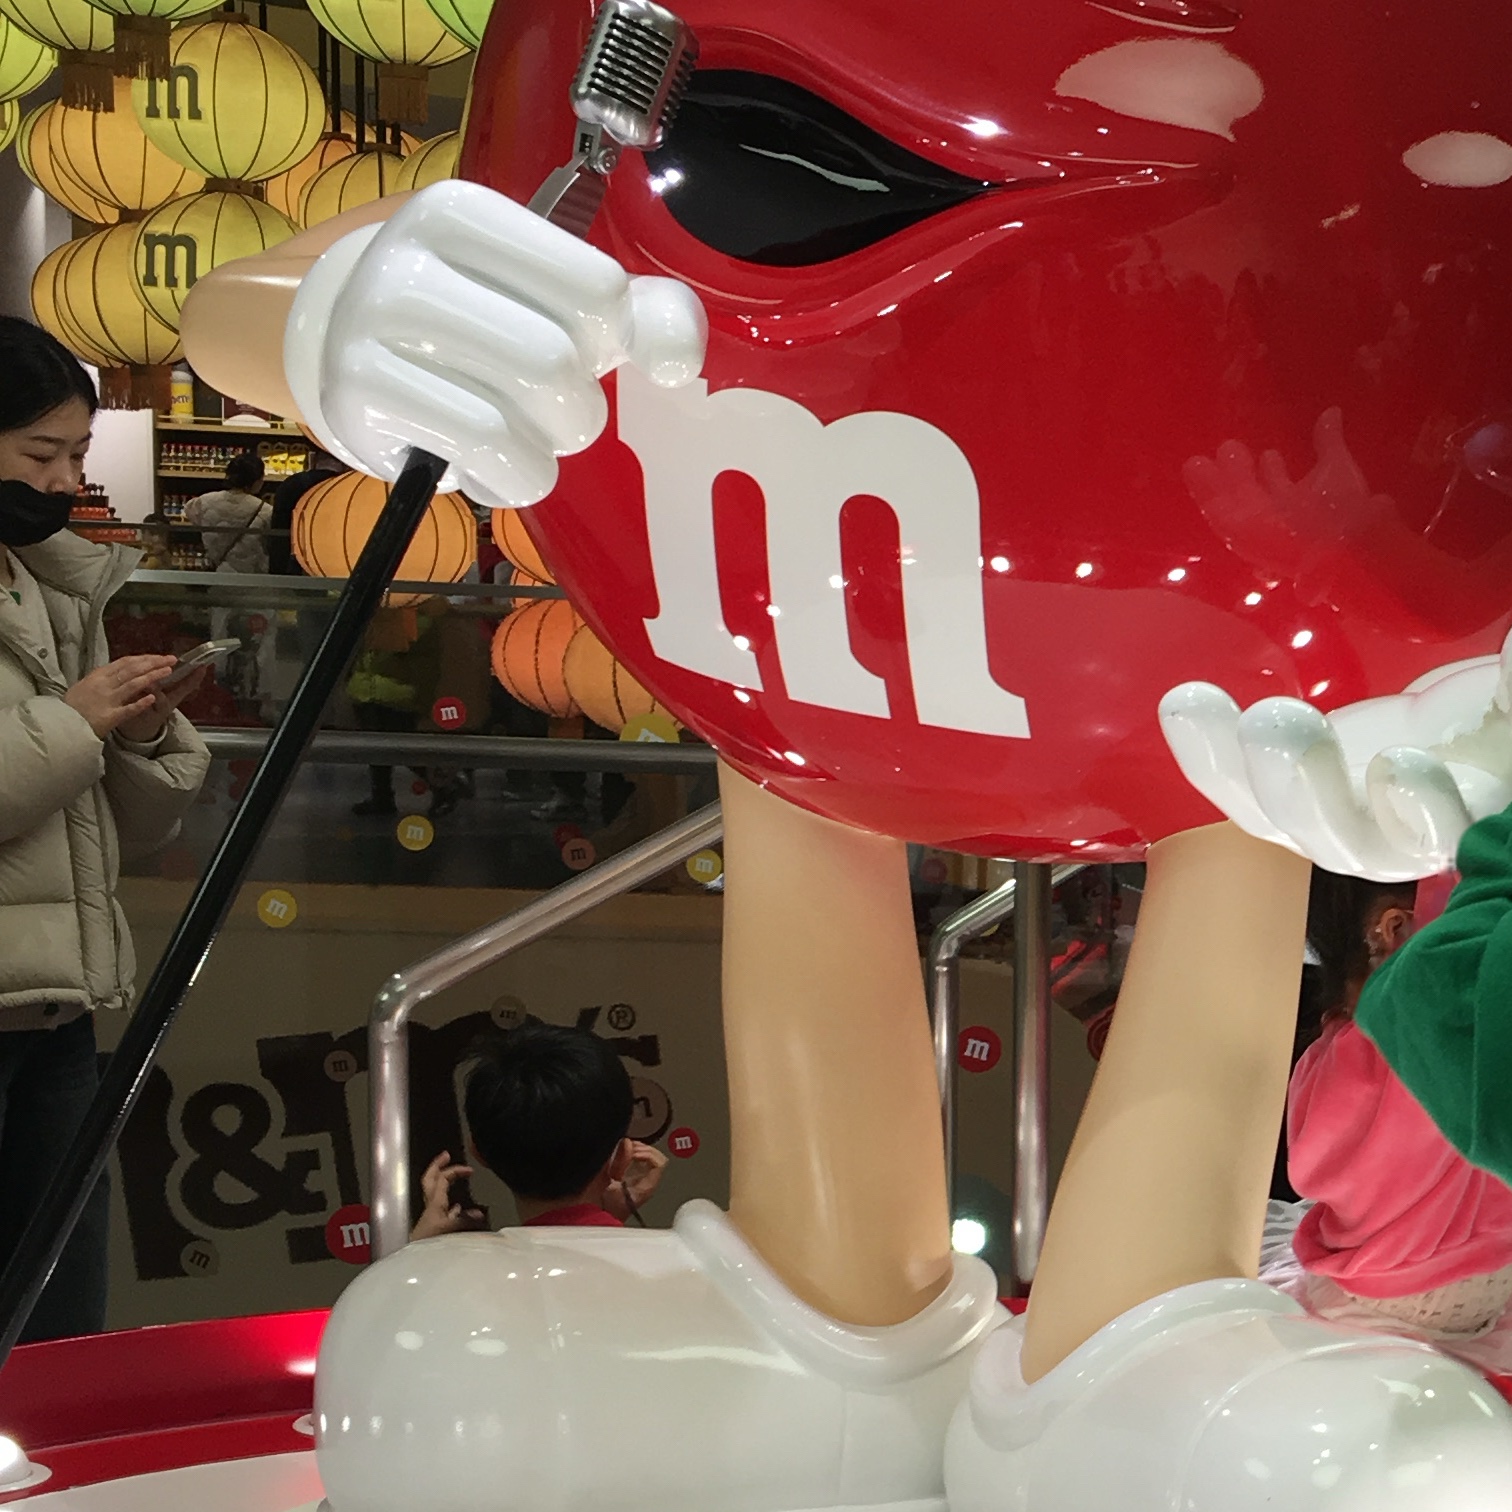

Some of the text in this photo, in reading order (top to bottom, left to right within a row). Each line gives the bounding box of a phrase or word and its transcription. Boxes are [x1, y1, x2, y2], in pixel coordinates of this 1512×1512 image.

[143, 233, 197, 288] m
[617, 367, 1030, 739] m
[440, 706, 459, 720] m
[406, 825, 425, 841] m
[695, 857, 714, 873] m
[264, 896, 290, 919] m
[964, 1038, 989, 1061] m
[675, 1135, 693, 1151] m
